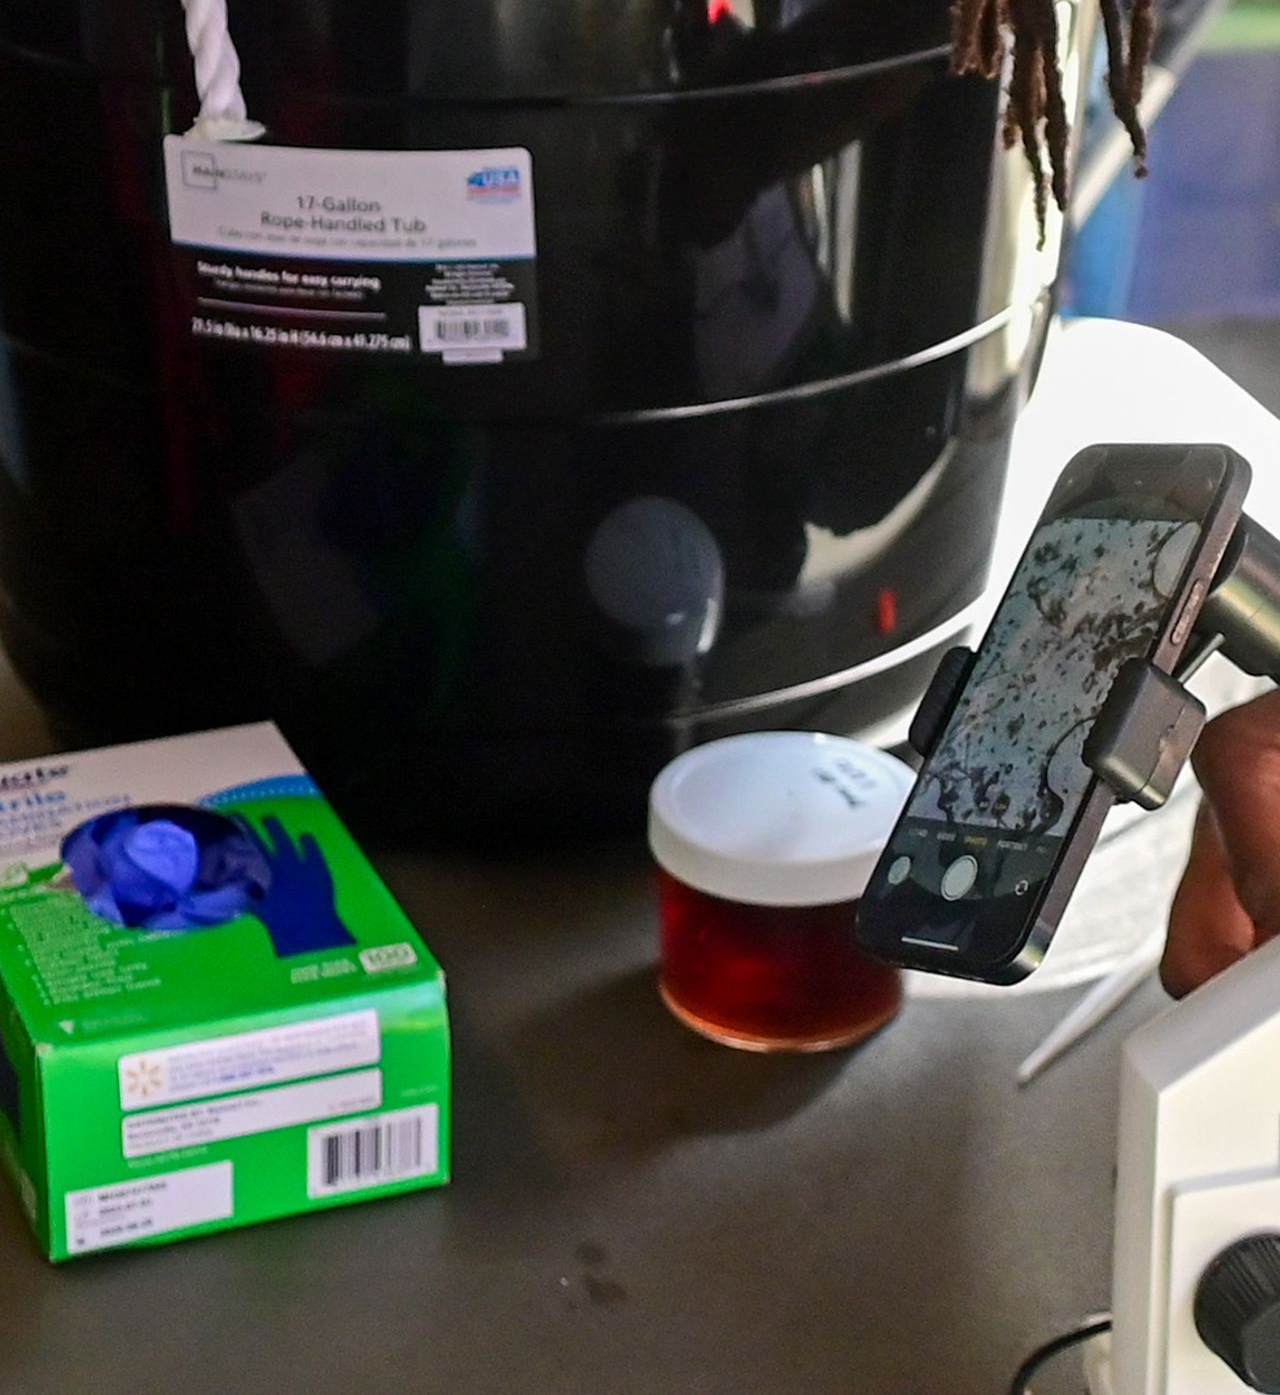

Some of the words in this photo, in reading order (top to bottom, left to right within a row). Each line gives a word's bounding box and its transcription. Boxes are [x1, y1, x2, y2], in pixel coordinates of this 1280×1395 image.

[297, 195, 382, 212] 17-Gallon
[261, 210, 385, 232] Rope-Handled
[391, 216, 426, 232] Tub
